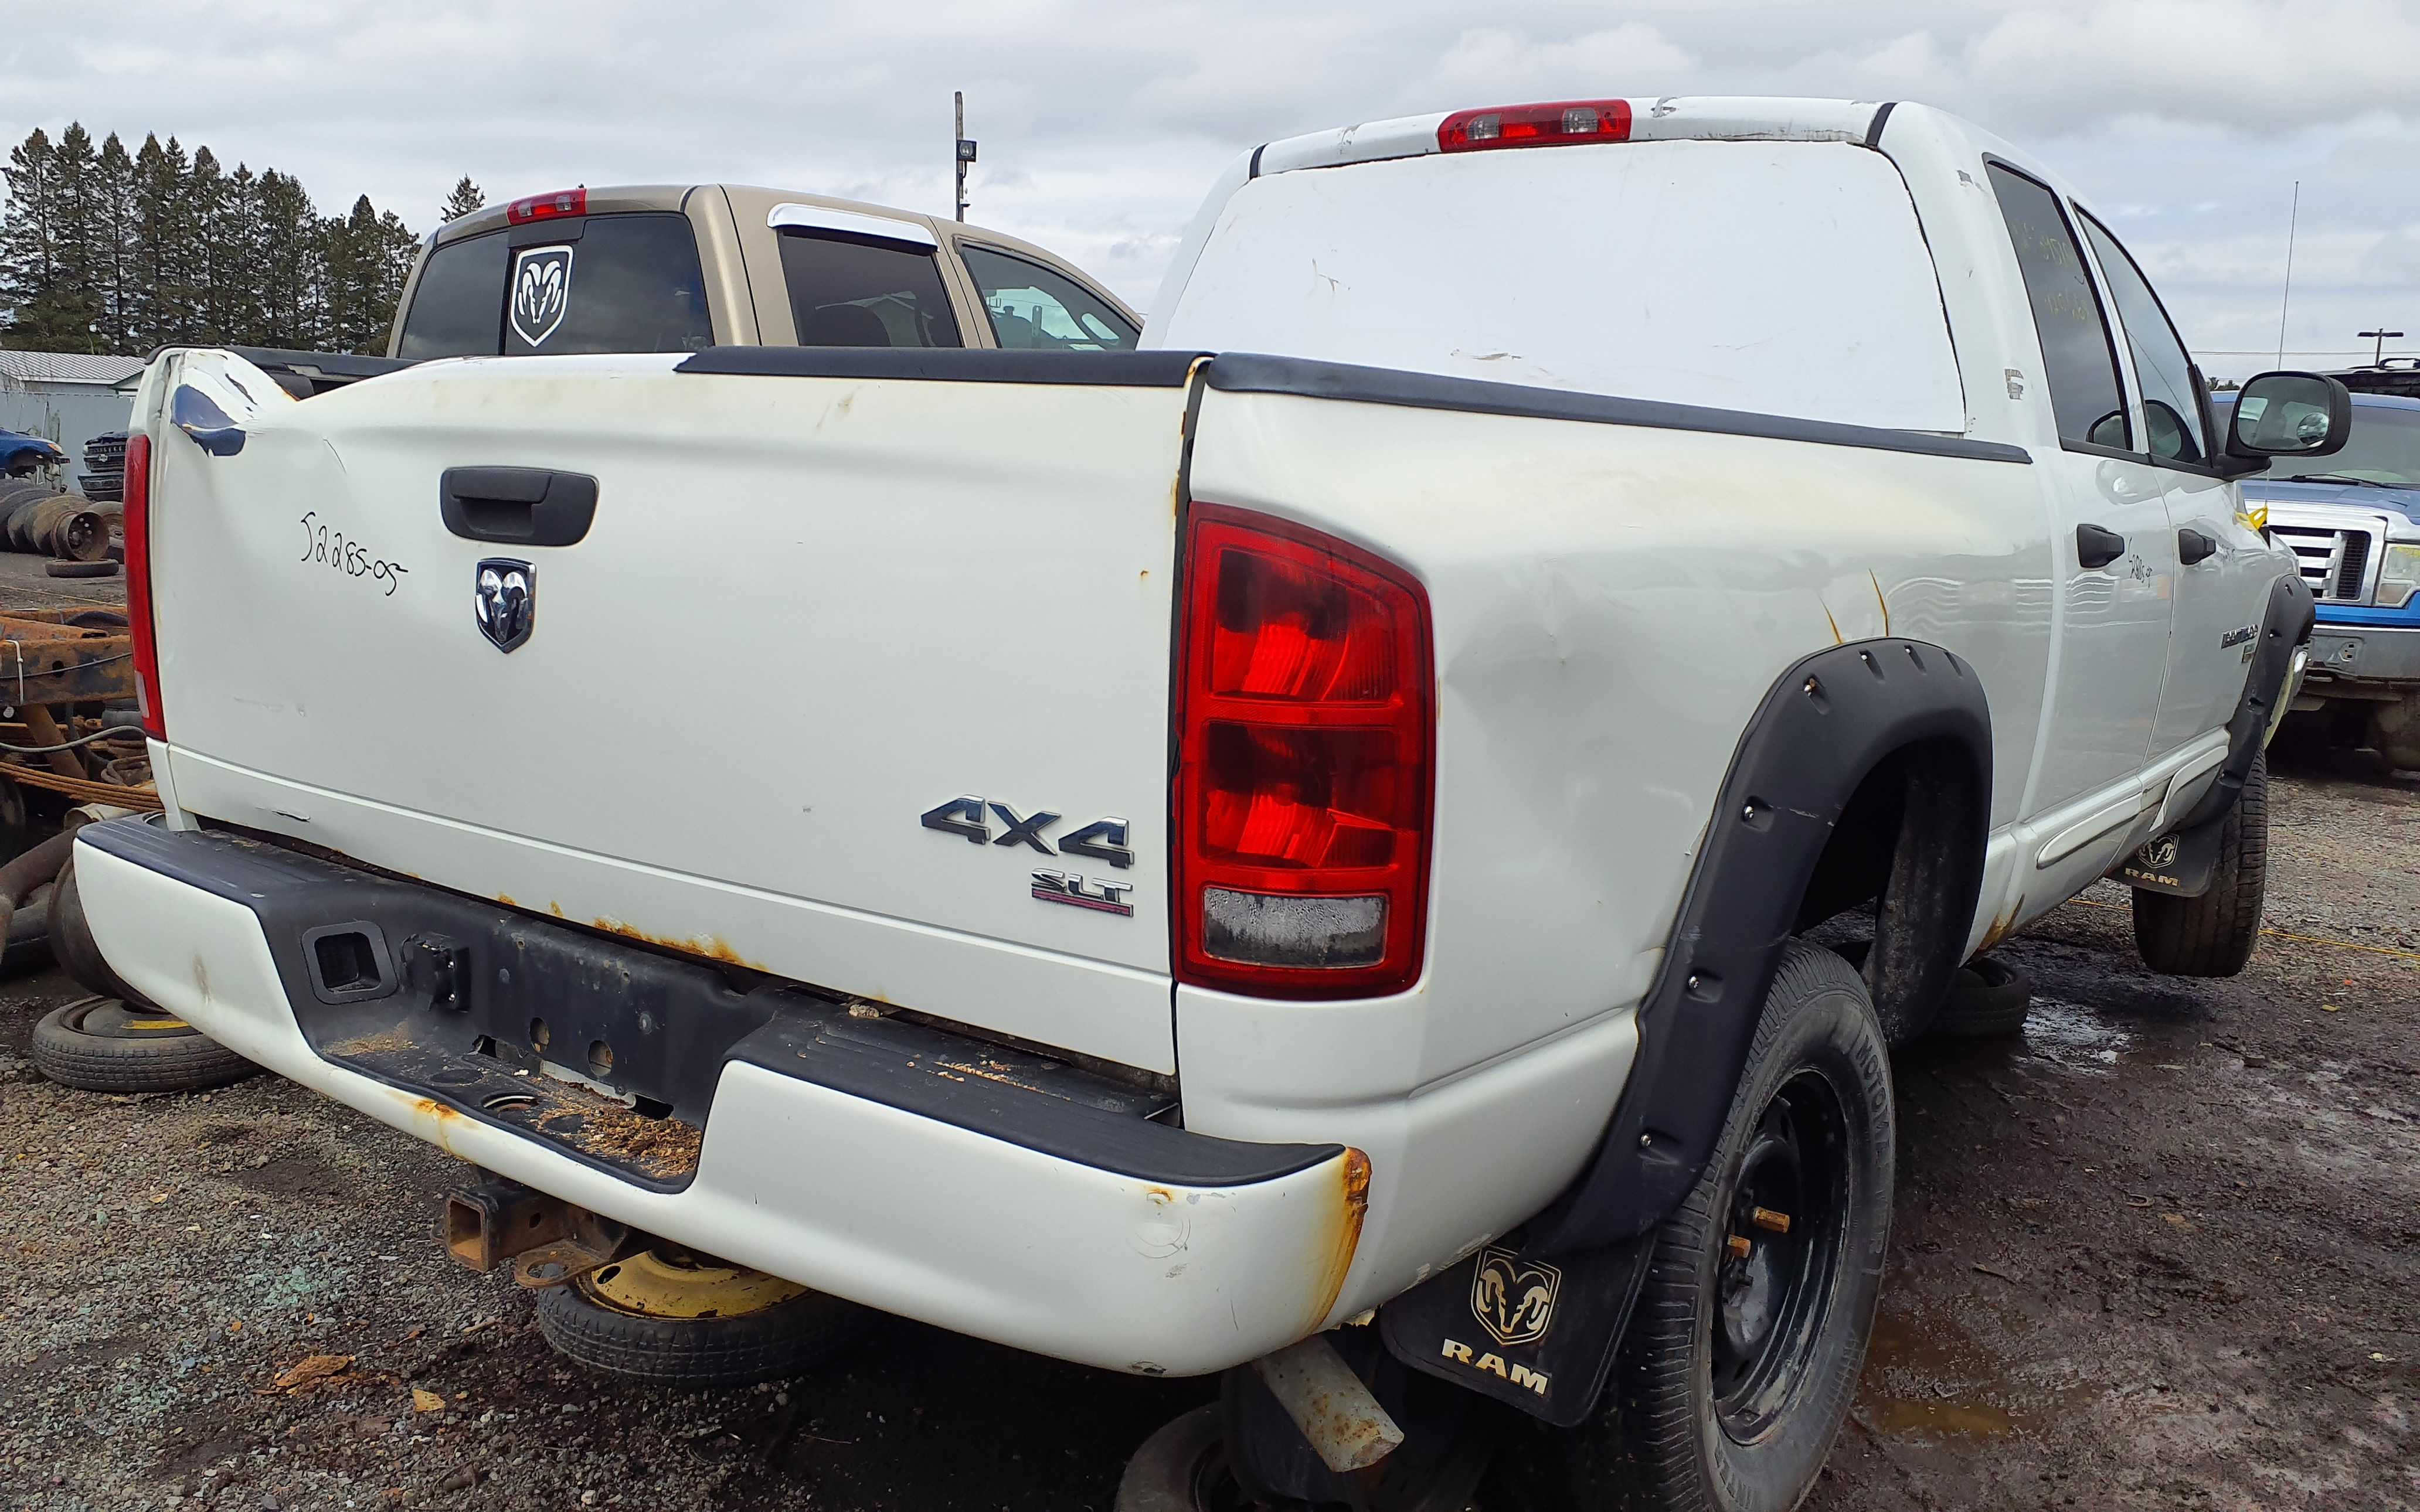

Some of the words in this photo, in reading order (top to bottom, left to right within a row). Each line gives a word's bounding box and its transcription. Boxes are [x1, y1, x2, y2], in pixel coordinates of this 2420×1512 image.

[301, 511, 409, 597] 52285-05
[1031, 867, 1133, 905] SLT
[2125, 867, 2180, 887] RAM
[1442, 1338, 1549, 1395] RAM
